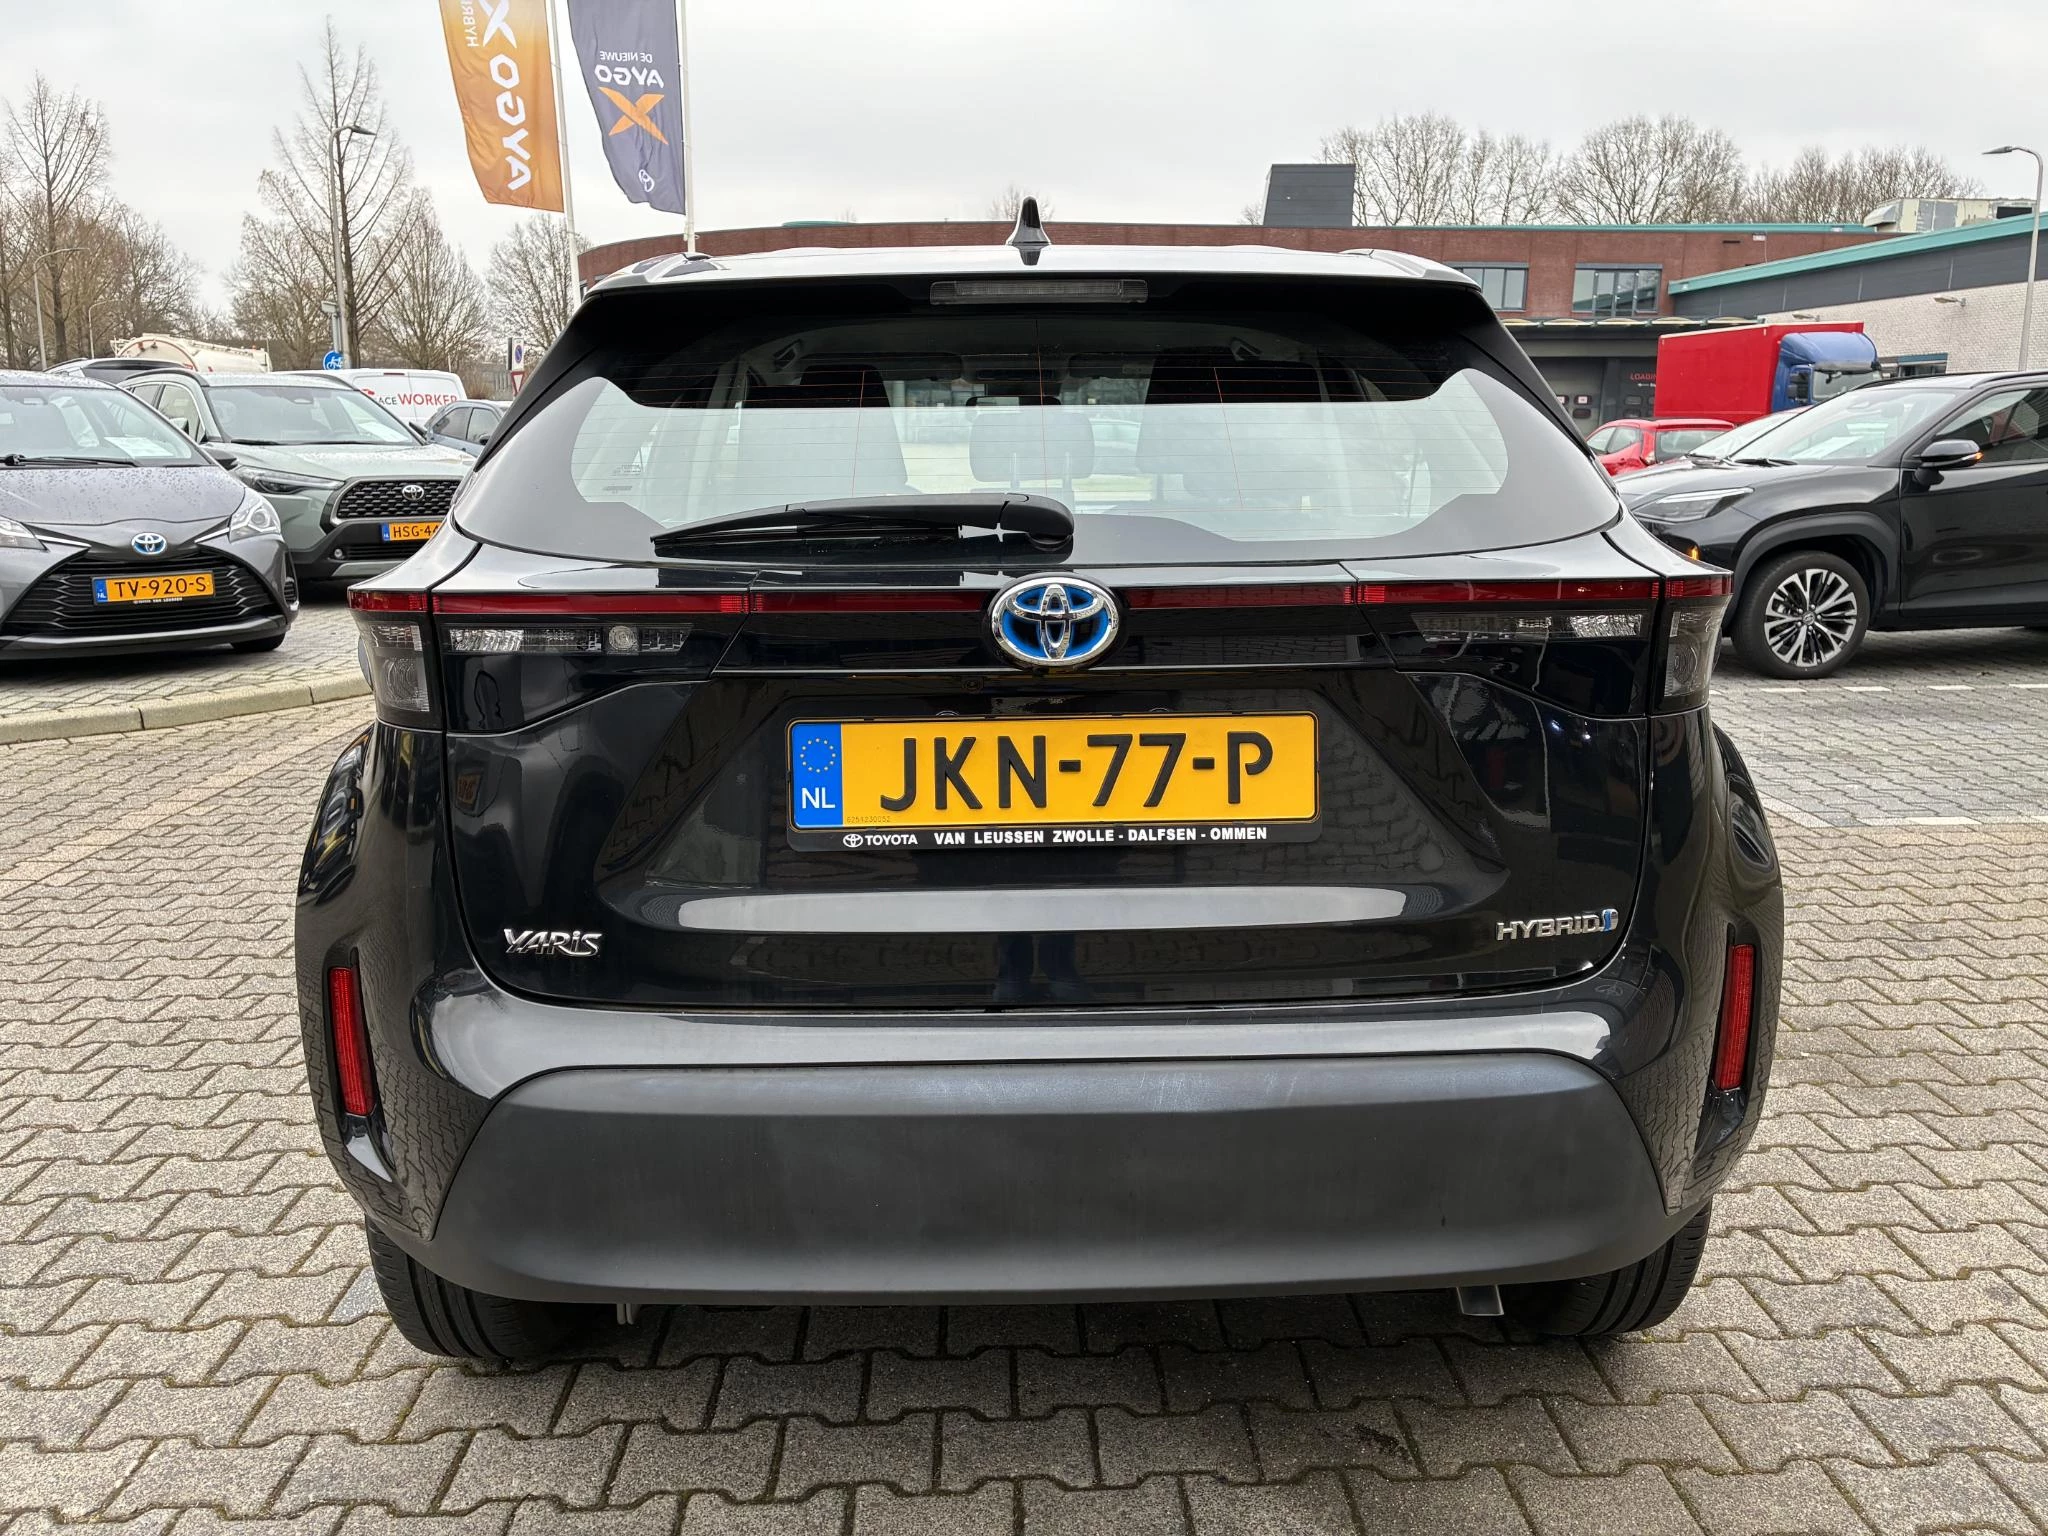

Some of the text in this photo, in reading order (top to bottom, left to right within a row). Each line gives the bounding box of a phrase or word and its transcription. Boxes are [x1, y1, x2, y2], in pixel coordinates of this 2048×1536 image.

[114, 577, 207, 598] TV-920-S
[880, 731, 1274, 812] JKN-77-P
[801, 787, 836, 809] NL
[865, 833, 918, 845] TOYOTA
[934, 832, 966, 844] VAN
[974, 830, 1045, 844] LEUSSEN
[1052, 829, 1115, 843] ZWOLLE
[1128, 828, 1197, 841] DALFSEN
[1210, 827, 1268, 840] OMMEN
[1496, 914, 1601, 941] HYBRID
